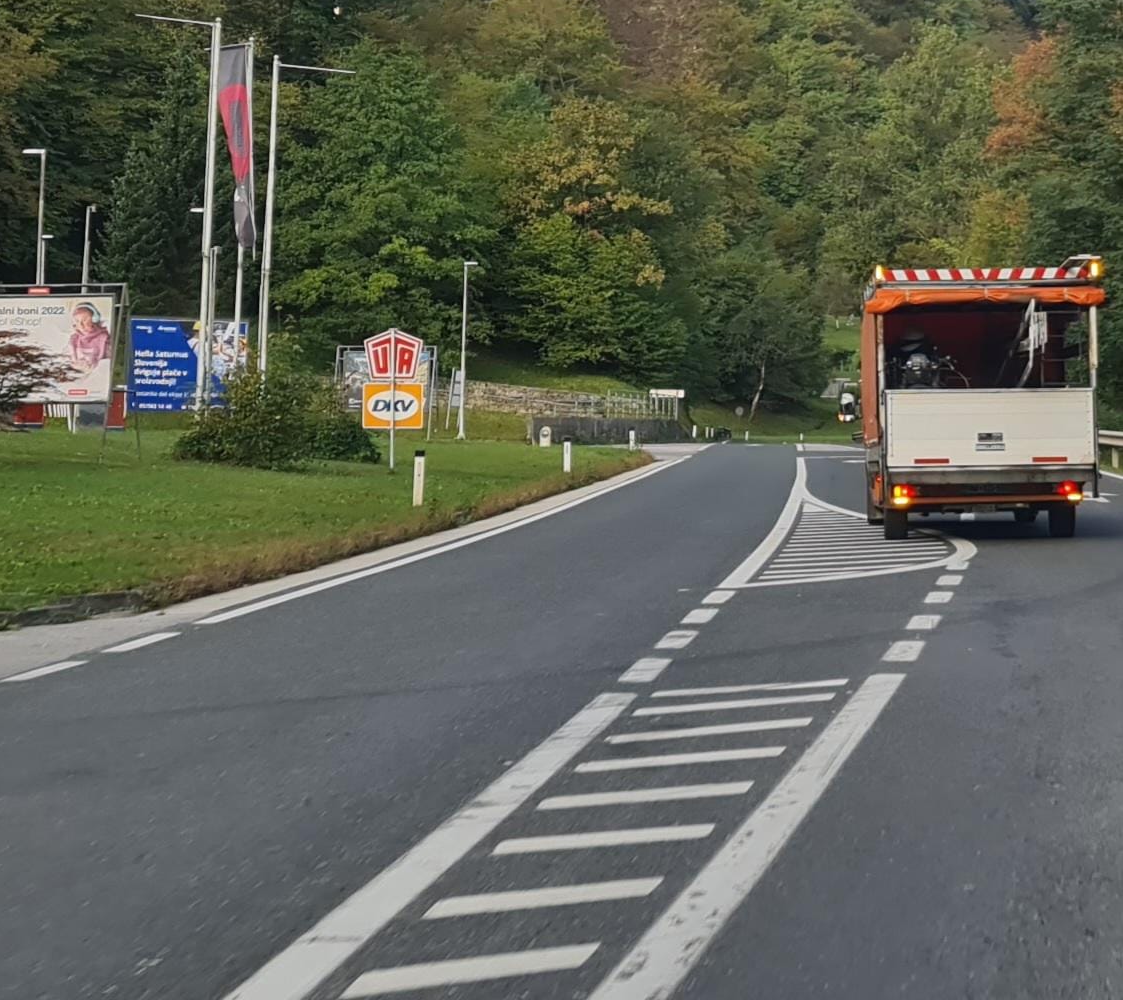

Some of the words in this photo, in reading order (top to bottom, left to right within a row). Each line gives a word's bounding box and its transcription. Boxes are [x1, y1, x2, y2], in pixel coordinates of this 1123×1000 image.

[17, 306, 39, 315] boni
[41, 306, 65, 315] 2022
[372, 400, 414, 412] DKV
